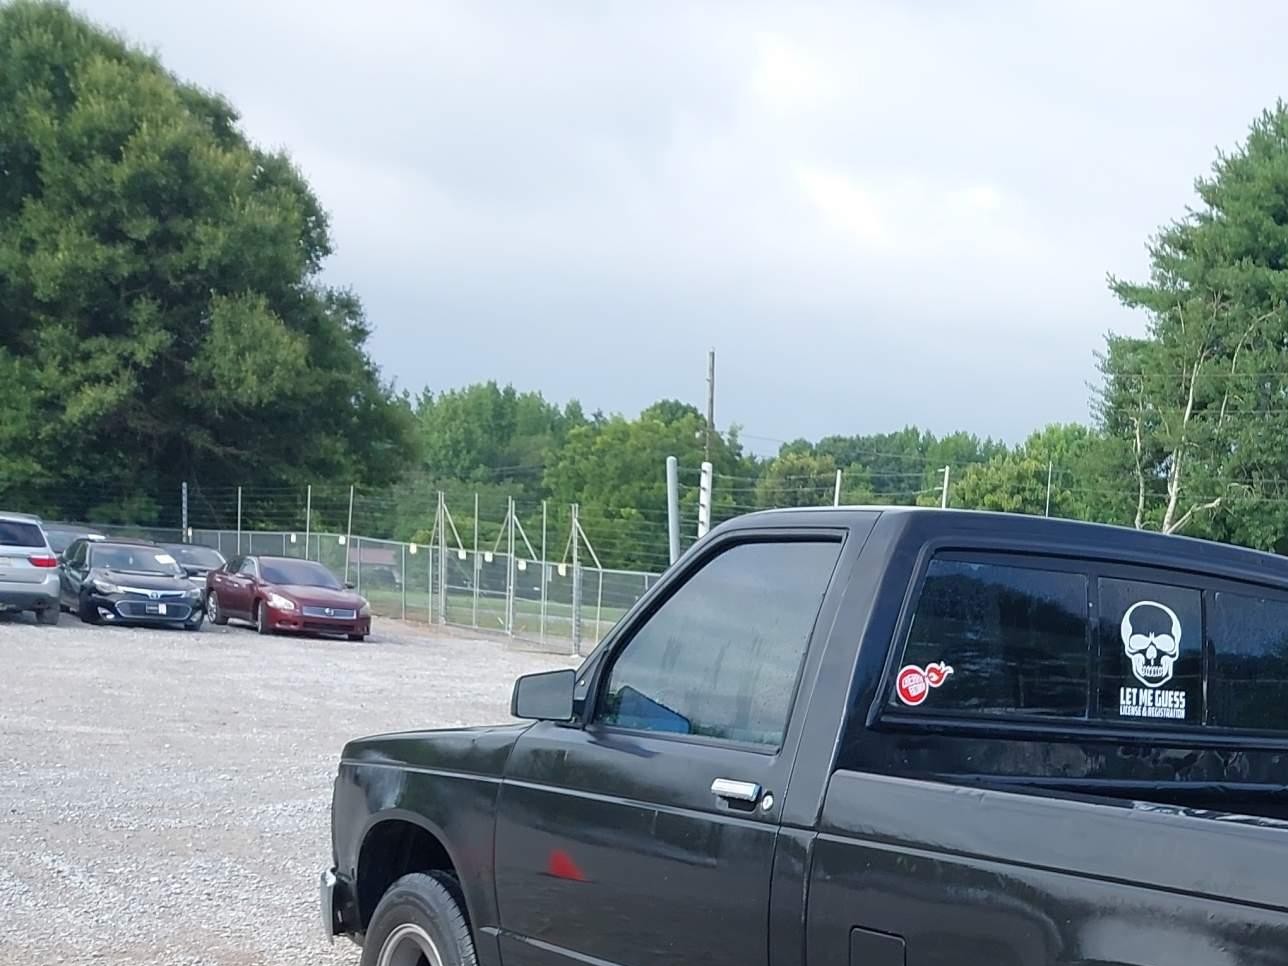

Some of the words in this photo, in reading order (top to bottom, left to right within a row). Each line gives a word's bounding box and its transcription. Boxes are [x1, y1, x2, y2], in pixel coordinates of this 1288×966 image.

[1120, 686, 1138, 706] LET
[1139, 688, 1154, 707] ME
[1154, 689, 1186, 709] GUESS
[1120, 705, 1142, 717] LICENSE
[1147, 706, 1186, 719] REGISTRATION
